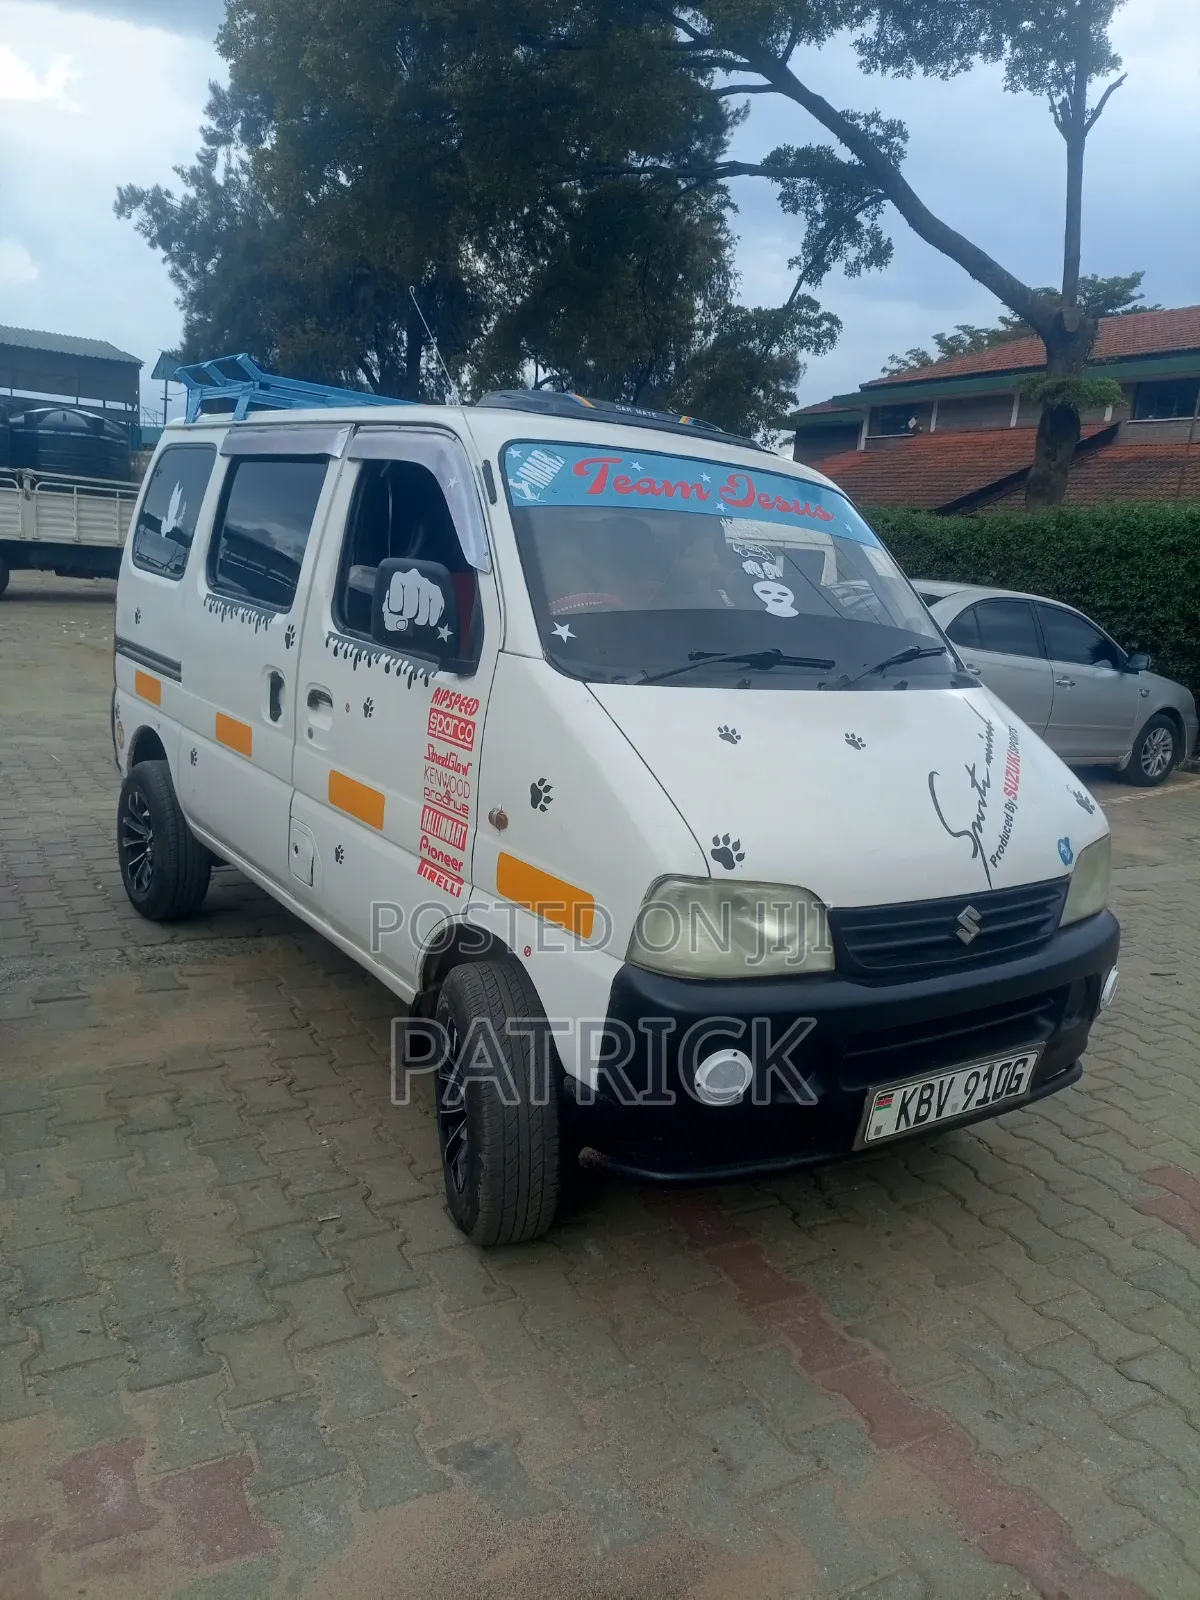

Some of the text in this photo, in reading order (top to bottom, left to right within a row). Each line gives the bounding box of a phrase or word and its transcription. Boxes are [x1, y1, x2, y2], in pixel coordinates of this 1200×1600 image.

[635, 408, 658, 418] MATE
[572, 457, 835, 522] Team Jesus
[431, 686, 480, 717] RIPSPEED
[429, 711, 474, 743] sparco
[424, 764, 471, 799] KENWOOD
[989, 813, 1014, 869] Produced
[1006, 798, 1019, 813] By
[419, 835, 464, 873] Pioneer
[417, 857, 464, 898] PIRELLI
[895, 1057, 1029, 1131] KBV 910G
